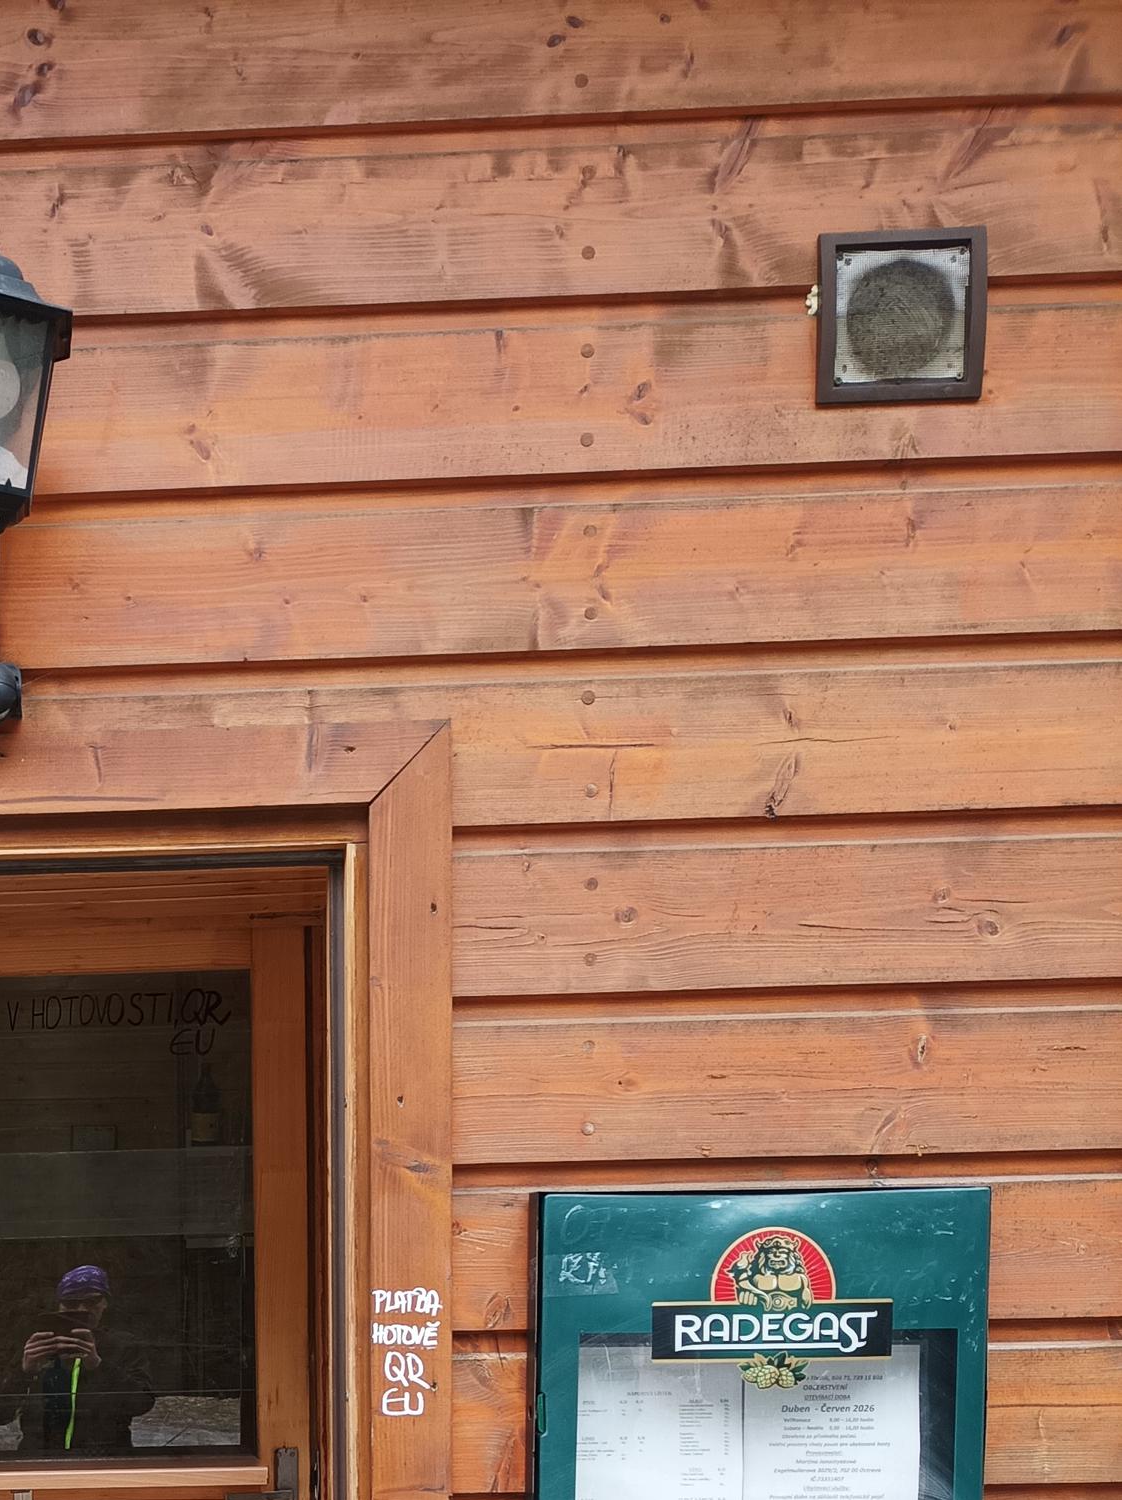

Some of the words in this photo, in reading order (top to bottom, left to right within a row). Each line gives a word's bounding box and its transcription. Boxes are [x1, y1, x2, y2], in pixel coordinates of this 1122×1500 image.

[7, 1001, 19, 1025] V
[372, 1287, 443, 1316] PLATBA
[372, 1321, 441, 1349] HOTOVĚ
[674, 1310, 877, 1354] RADEGAST
[384, 1351, 431, 1389] QR
[382, 1388, 424, 1416] EU
[781, 1404, 810, 1413] Duben
[820, 1403, 851, 1413] Červen
[853, 1404, 875, 1412] 2026
